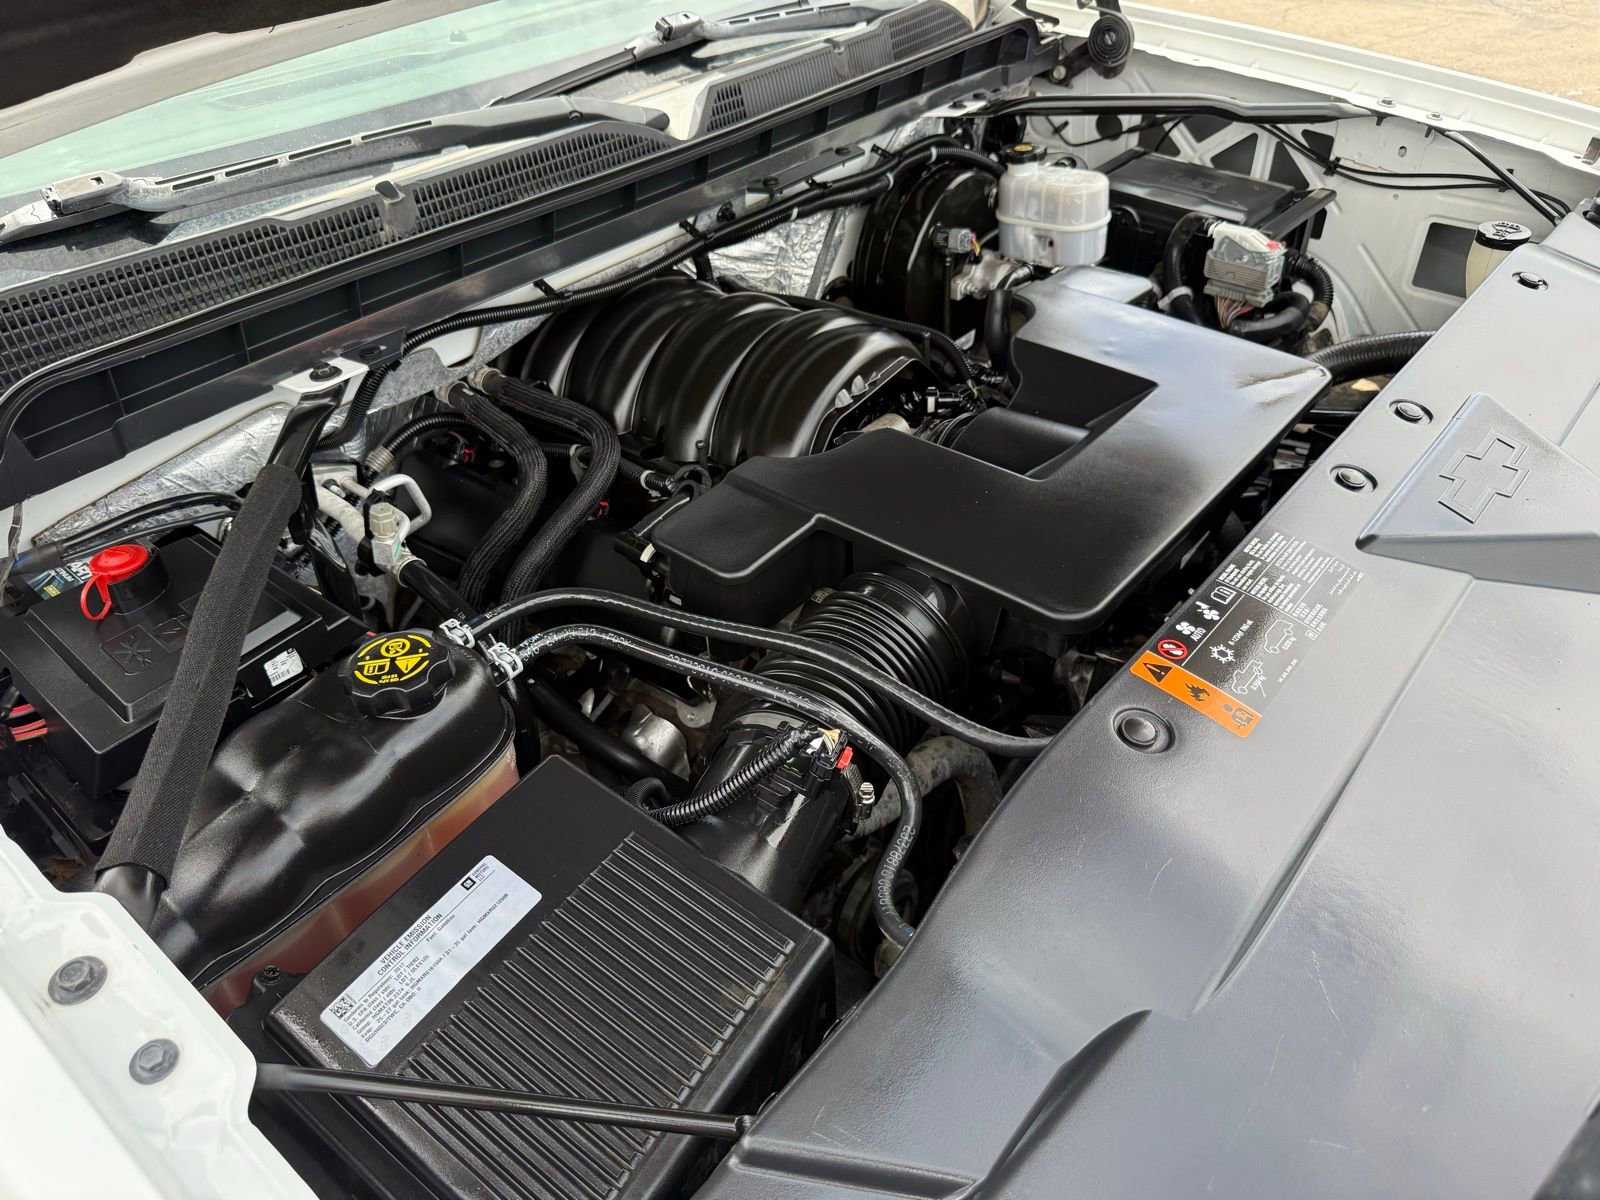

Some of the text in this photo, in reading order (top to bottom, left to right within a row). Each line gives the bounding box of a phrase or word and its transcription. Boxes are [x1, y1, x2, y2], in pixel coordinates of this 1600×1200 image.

[1190, 627, 1206, 642] AUTO
[376, 912, 443, 976] CONTROL INFORMATION
[379, 914, 431, 964] VEHICLE EMISSION
[343, 1002, 364, 1022] Conforms
[393, 962, 405, 974] 2017
[351, 1009, 373, 1030] California
[371, 999, 383, 1011] class
[398, 974, 408, 985] LDT
[357, 1006, 368, 1016] EPA
[366, 995, 378, 1007] class
[393, 971, 404, 981] LDT
